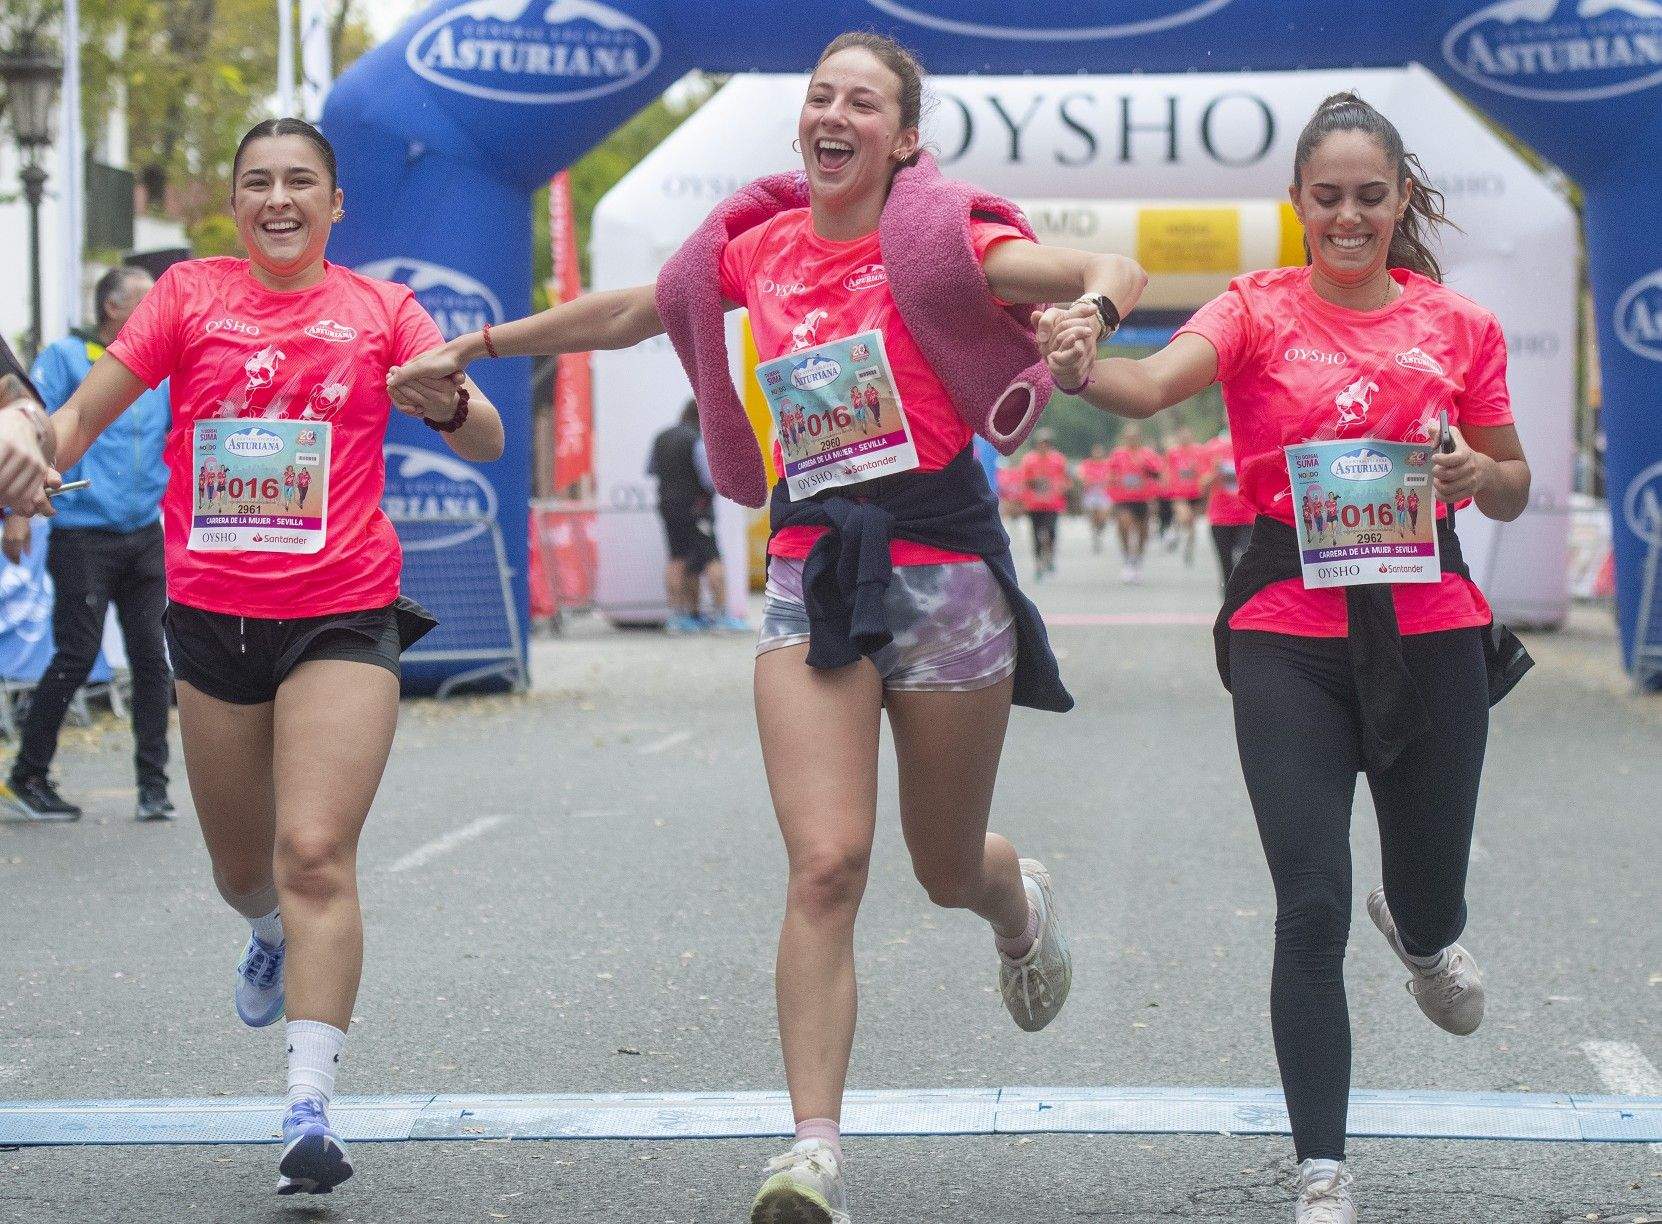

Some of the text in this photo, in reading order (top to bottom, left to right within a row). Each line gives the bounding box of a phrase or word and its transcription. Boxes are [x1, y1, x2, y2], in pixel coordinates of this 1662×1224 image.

[422, 25, 641, 77] ASTURIANA
[1283, 348, 1347, 365] OYSHO
[807, 405, 852, 437] 016
[228, 437, 280, 451] ASTURIANA
[820, 437, 841, 451] 2960
[817, 455, 825, 464] DE
[825, 453, 833, 462] LA
[859, 440, 888, 452] SEVILLA
[852, 455, 897, 474] Santander
[1296, 459, 1319, 469] SUMA
[1336, 462, 1388, 475] ASTURIANA
[798, 470, 833, 490] OYSHO
[228, 477, 280, 499] 016
[237, 504, 262, 514] 2961
[1341, 503, 1394, 528] 016
[206, 517, 229, 525] CARRERA
[248, 517, 271, 525] MUJER
[277, 518, 303, 526] SEVILLA
[202, 532, 237, 543] OYSHO
[264, 534, 308, 545] Santander
[1357, 533, 1383, 544] 2962
[1319, 545, 1418, 558] CARRERA DE LA MUJER SEVILLA
[1318, 565, 1360, 579] OYSHO
[1388, 563, 1423, 574] Santander
